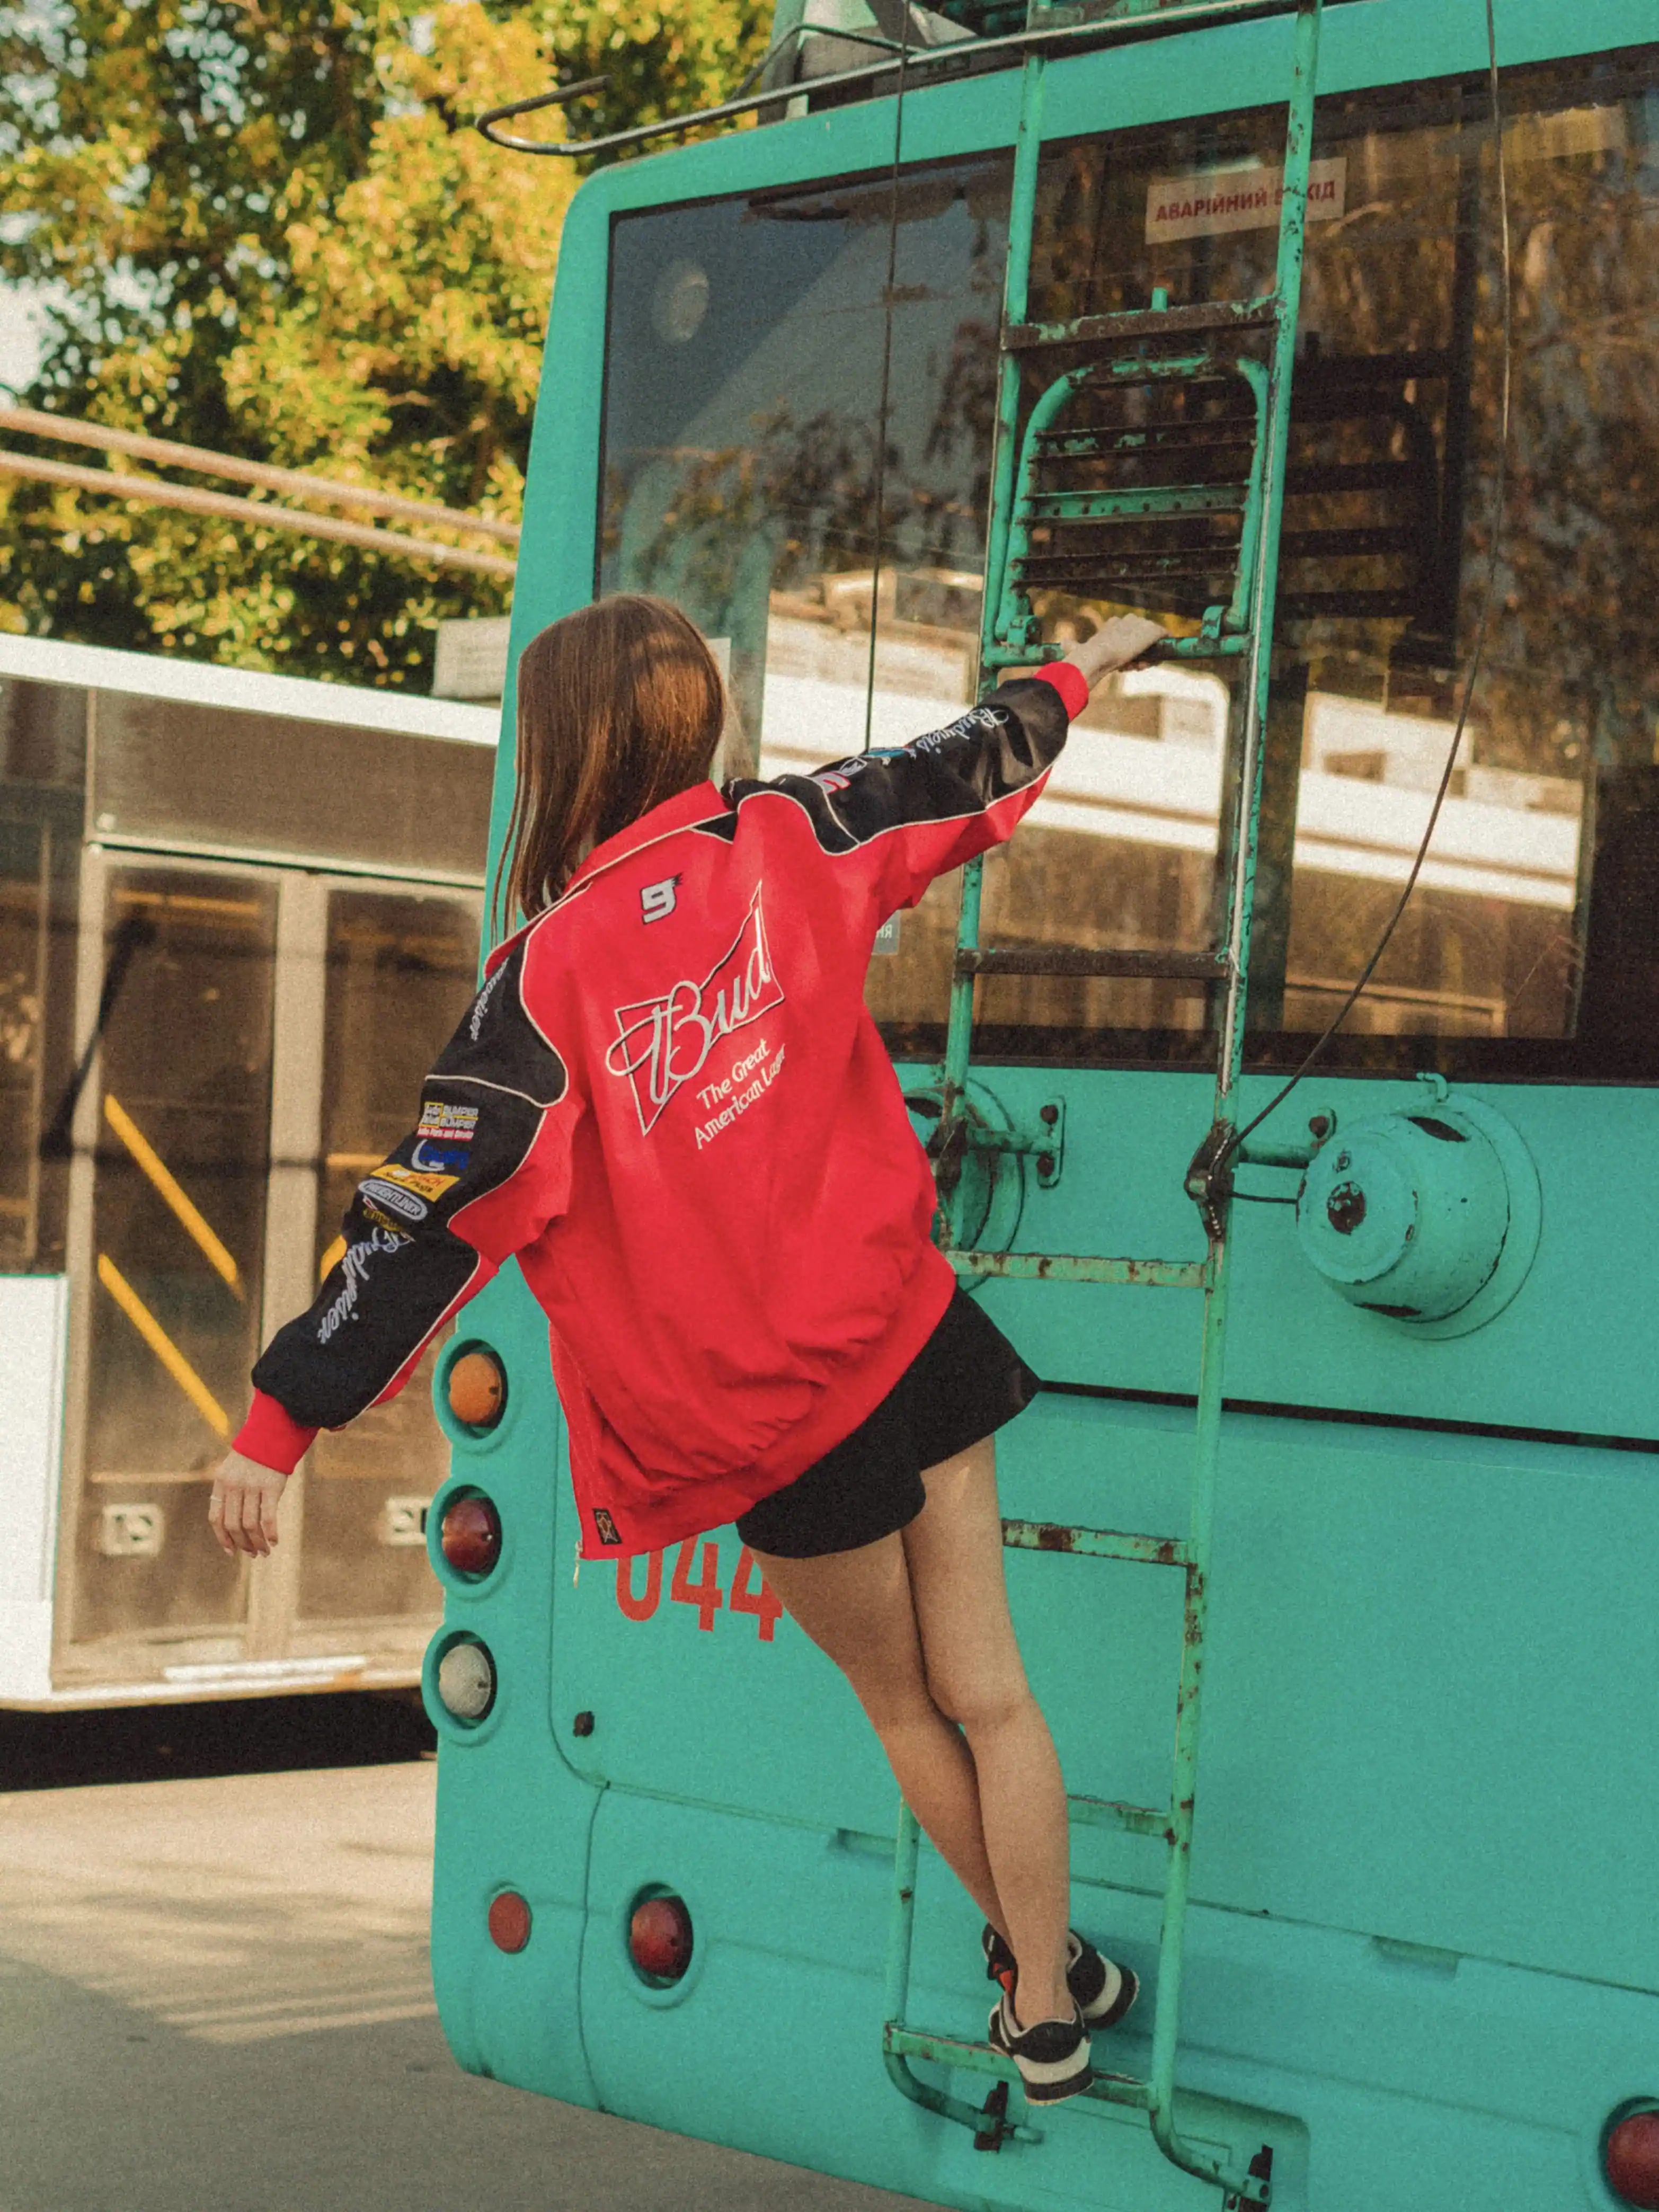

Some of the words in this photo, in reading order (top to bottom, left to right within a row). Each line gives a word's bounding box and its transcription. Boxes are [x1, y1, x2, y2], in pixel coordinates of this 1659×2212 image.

[1274, 180, 1335, 206] ВХІД
[640, 872, 682, 925] 9
[606, 907, 771, 1104] Bud
[696, 1079, 733, 1109] The
[732, 1038, 771, 1082] Great
[694, 1079, 765, 1150] American
